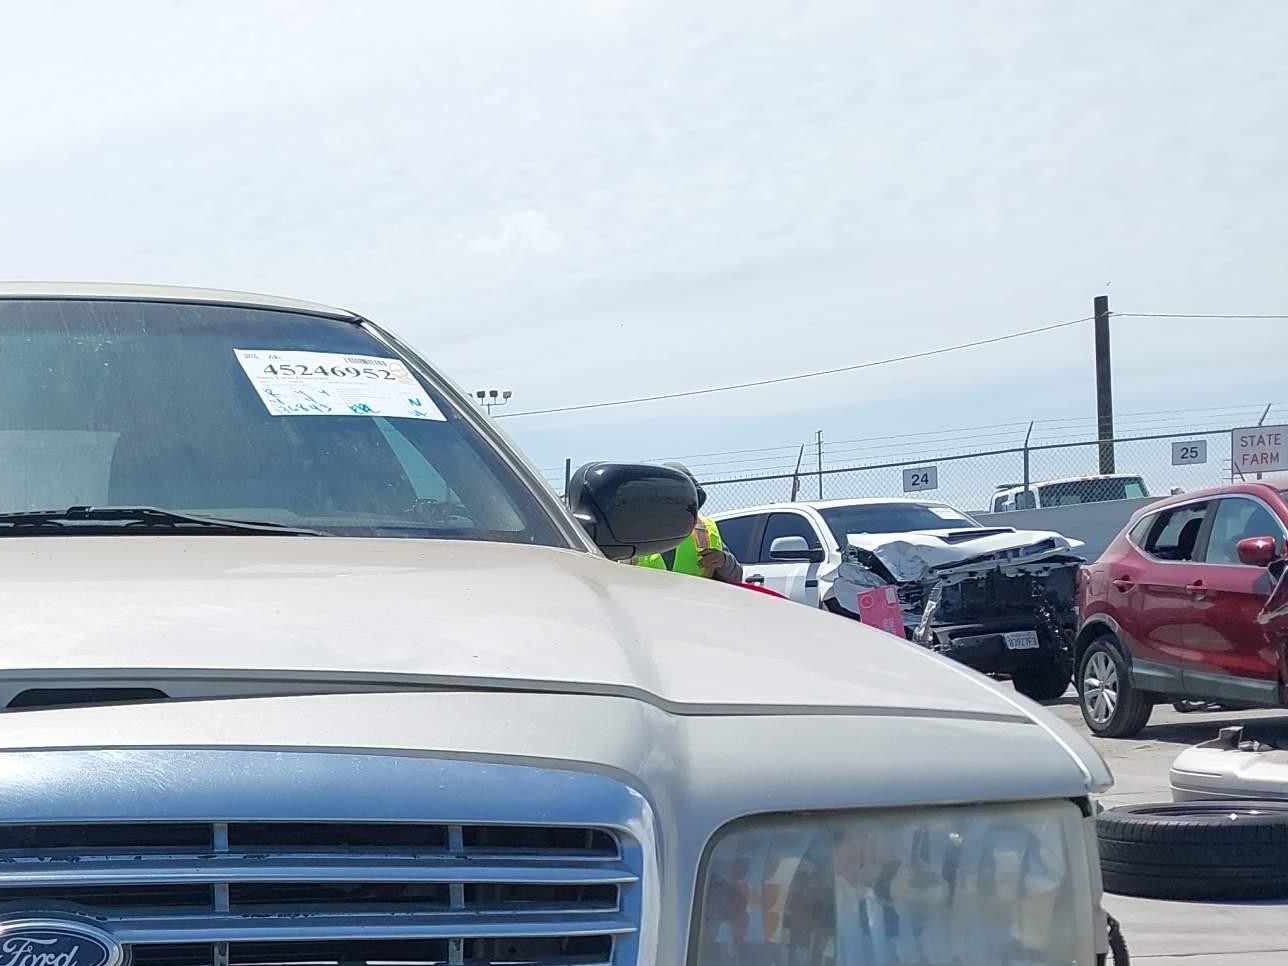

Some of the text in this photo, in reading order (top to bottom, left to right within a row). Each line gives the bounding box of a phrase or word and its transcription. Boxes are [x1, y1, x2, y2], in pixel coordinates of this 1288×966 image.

[263, 363, 397, 381] 45246952
[1240, 433, 1282, 448] STATE
[1179, 446, 1199, 460] 25
[1242, 452, 1280, 466] FARM
[910, 472, 929, 487] 24
